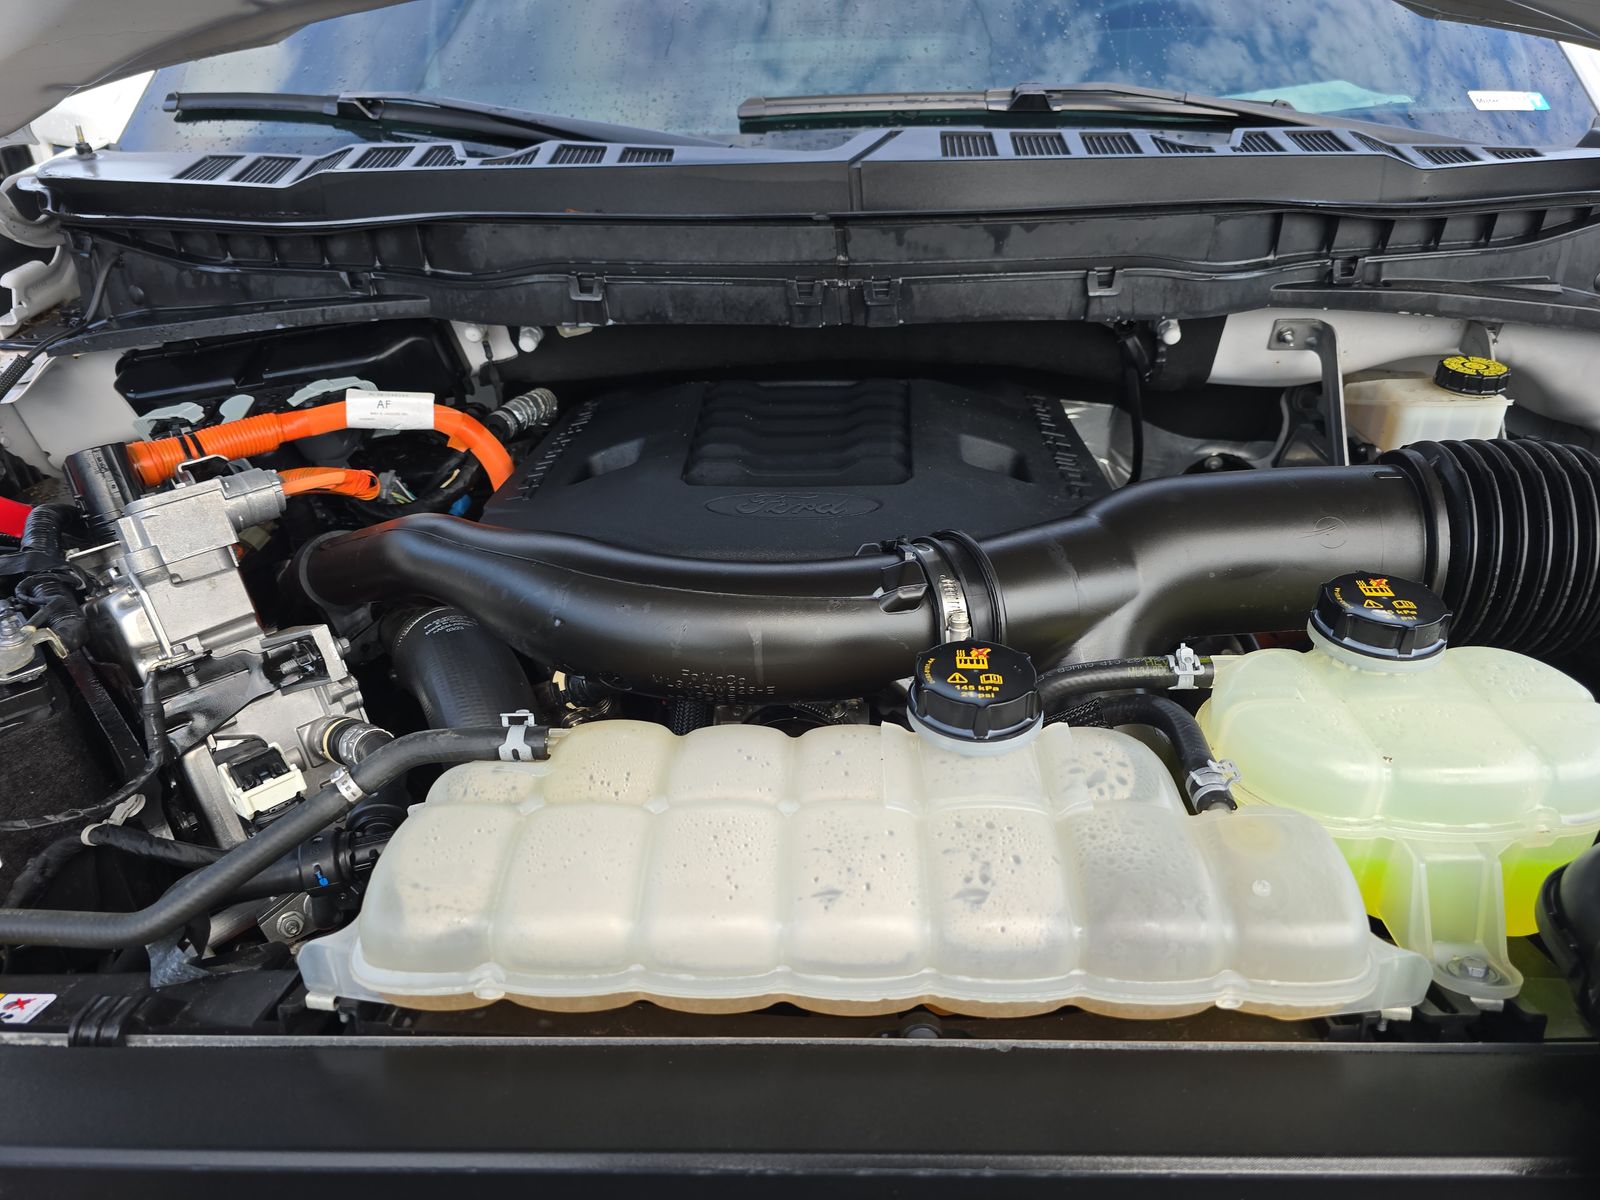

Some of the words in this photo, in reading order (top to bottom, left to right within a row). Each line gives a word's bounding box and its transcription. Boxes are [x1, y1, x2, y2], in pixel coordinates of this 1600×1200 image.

[376, 399, 392, 409] AF
[735, 493, 852, 515] Ford
[954, 684, 976, 692] 145
[978, 684, 1000, 692] kPa
[976, 691, 995, 699] psi
